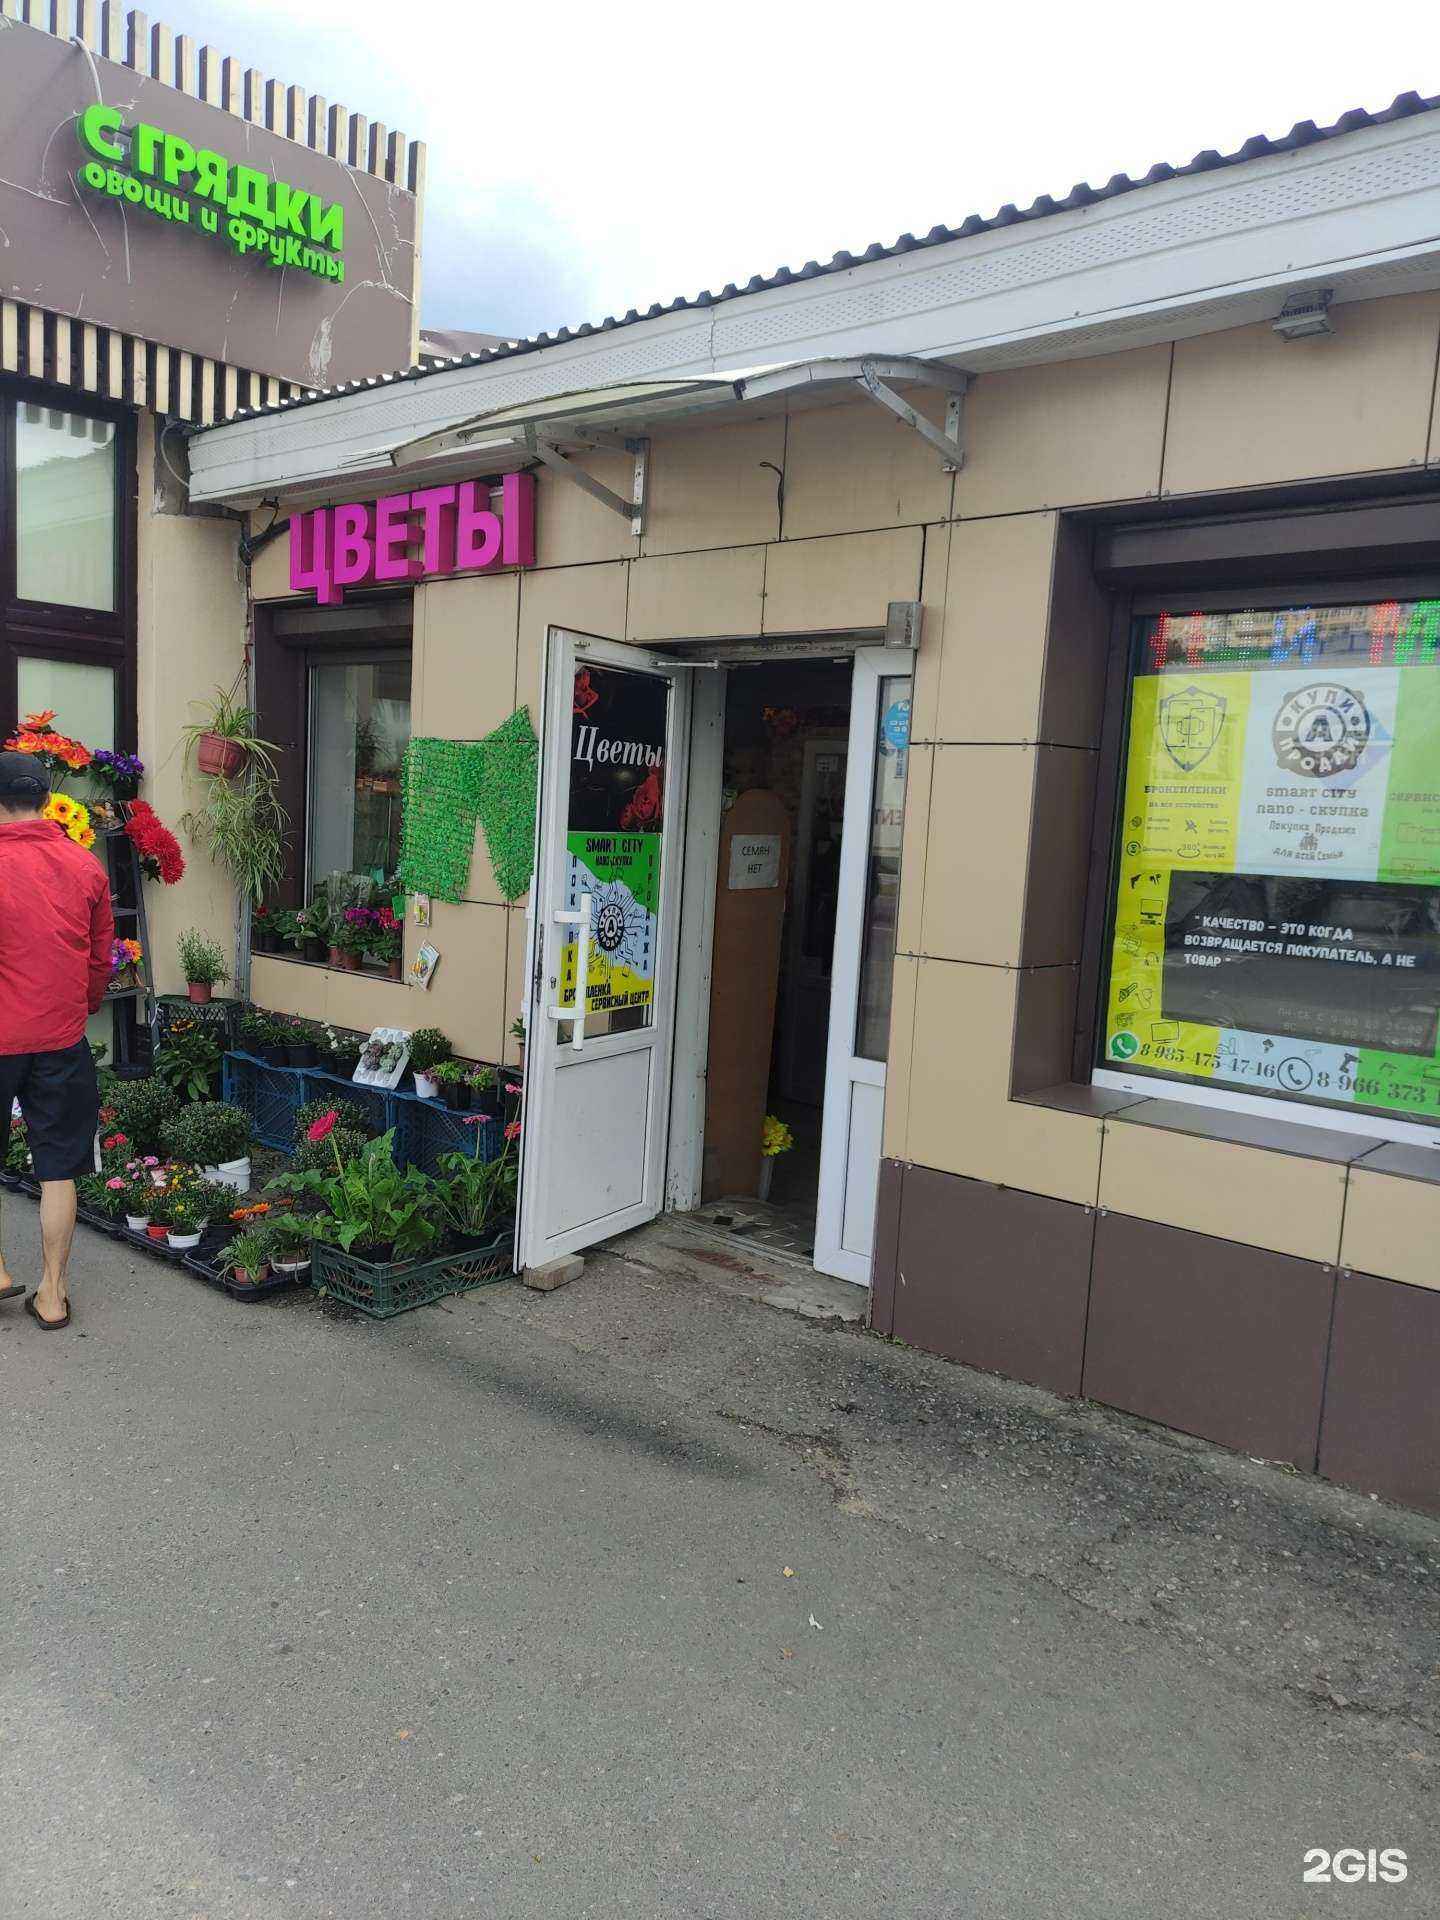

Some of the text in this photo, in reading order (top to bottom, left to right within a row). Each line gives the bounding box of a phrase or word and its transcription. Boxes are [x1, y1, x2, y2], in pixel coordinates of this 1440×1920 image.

[77, 104, 345, 253] С ГРЯДКИ
[79, 161, 345, 284] овощи и фрукты
[289, 472, 536, 605] ЦВЕТЫ
[1290, 690, 1354, 714] КУПИ
[574, 725, 664, 772] Цветы
[586, 838, 643, 853] SMART CITY
[742, 845, 770, 857] СЕМЯН
[748, 863, 763, 874] НЕТ
[1202, 916, 1265, 932] КАЧЕСТВО
[1280, 922, 1305, 936] ЭТО
[1308, 924, 1354, 941] КОГДА
[1184, 934, 1416, 968] ВОЗВРАЩАЕТСЯ ПОКУПАТЕЛЬ, А НЕ
[1184, 953, 1221, 967] ТОВАР
[591, 990, 650, 1011] СЕРВИСНЫЙ ЦЕНТР
